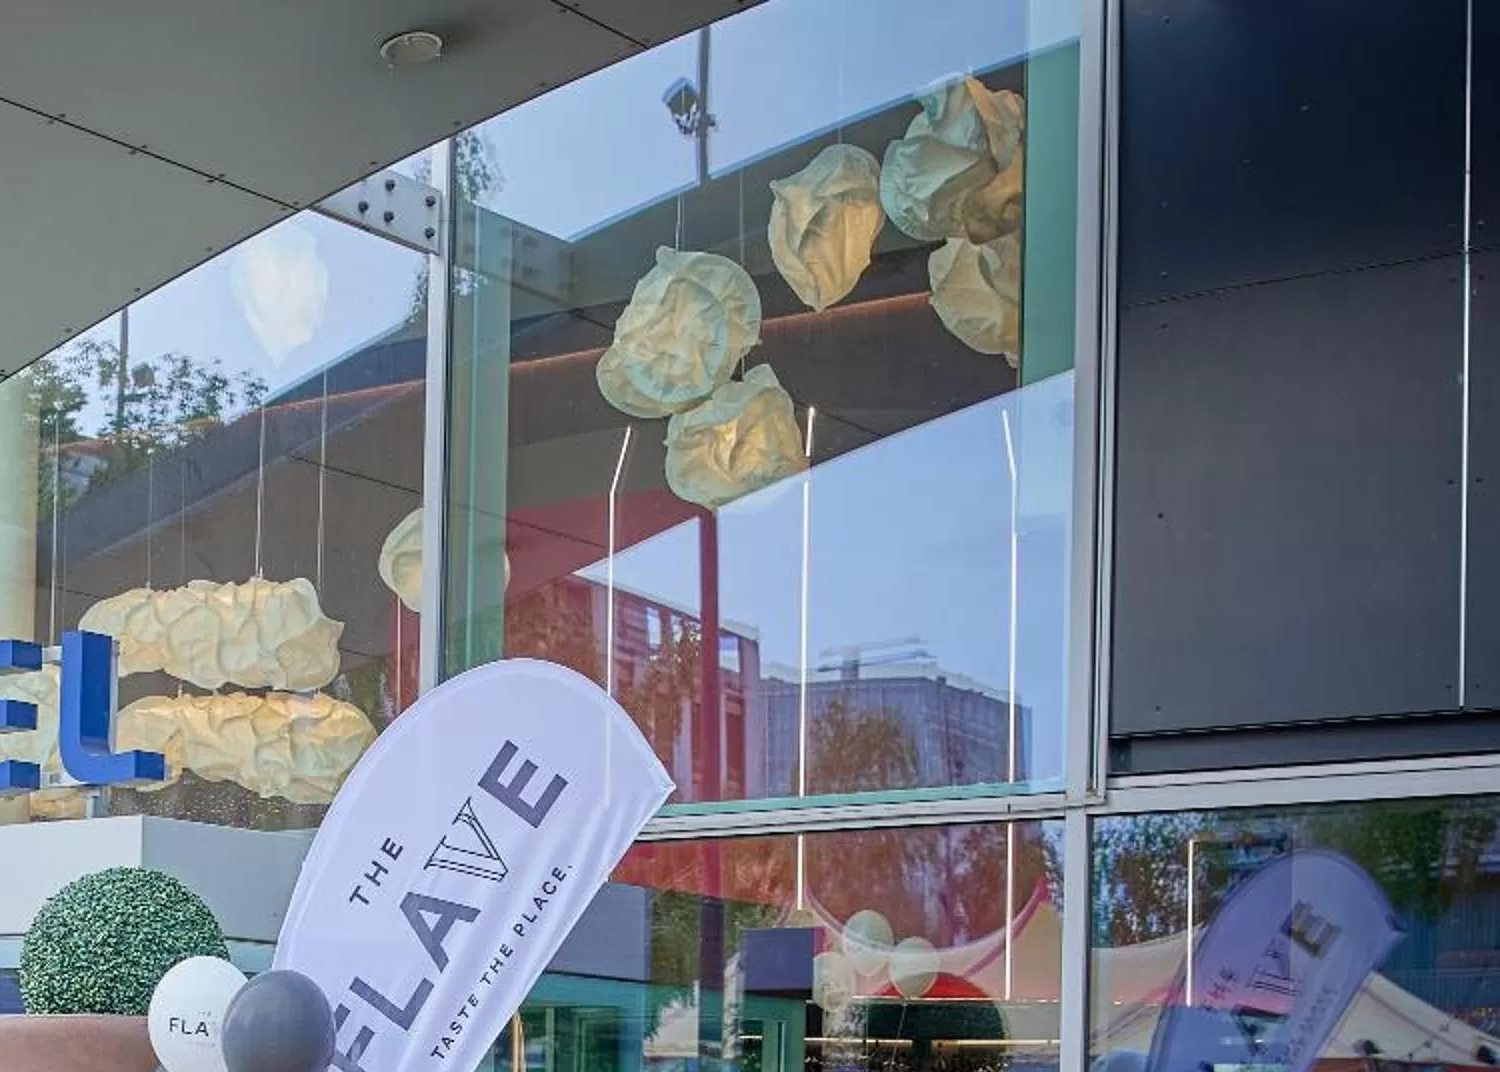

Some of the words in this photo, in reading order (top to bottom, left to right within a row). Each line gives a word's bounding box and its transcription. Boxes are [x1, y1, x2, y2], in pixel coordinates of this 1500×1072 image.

[349, 837, 403, 906] THE
[430, 992, 480, 1062] TASTE
[479, 942, 514, 986] THE
[512, 864, 573, 938] PLACE.
[168, 1017, 217, 1038] FLA
